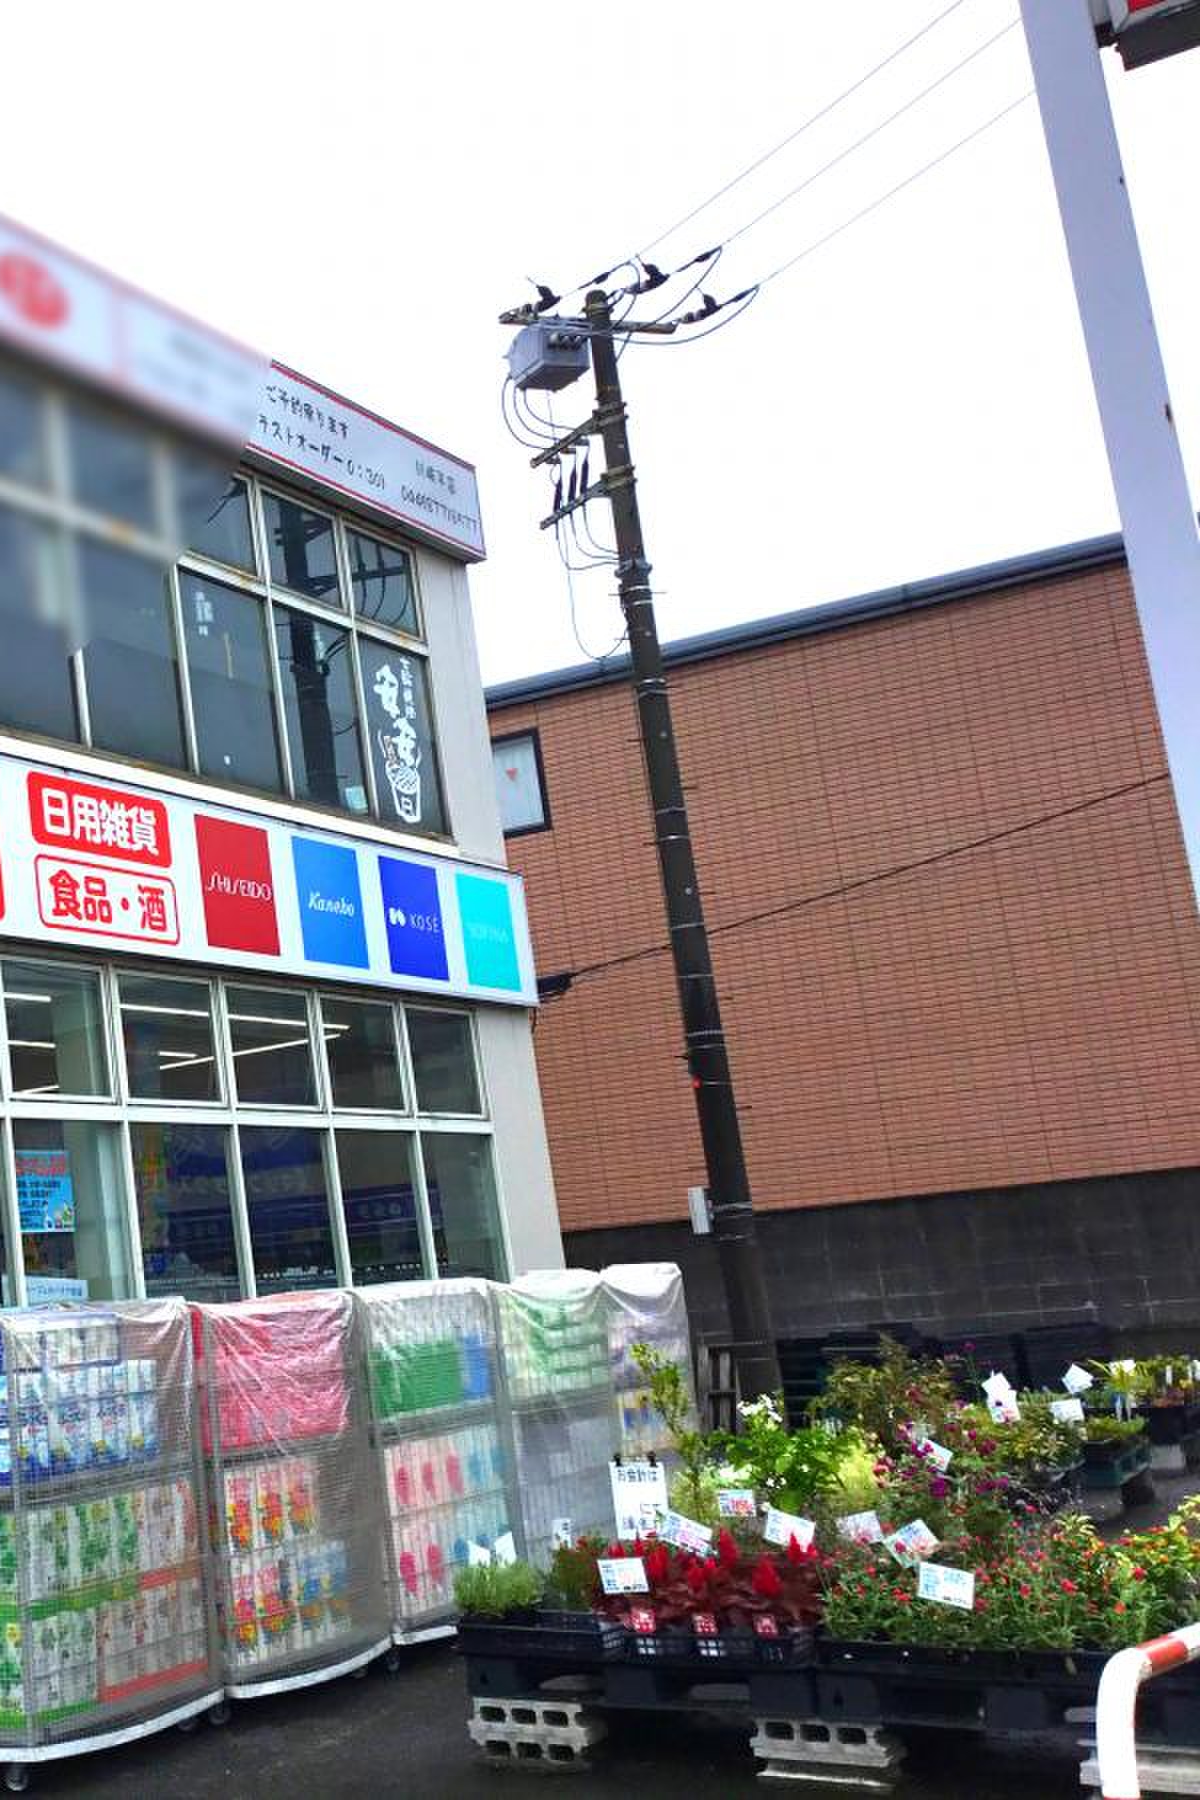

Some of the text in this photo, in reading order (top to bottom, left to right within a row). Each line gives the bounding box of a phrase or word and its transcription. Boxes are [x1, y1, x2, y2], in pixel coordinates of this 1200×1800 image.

[40, 790, 159, 857] 日用雑貨
[206, 871, 272, 903] SHISEIDO
[307, 891, 356, 918] Kanebo
